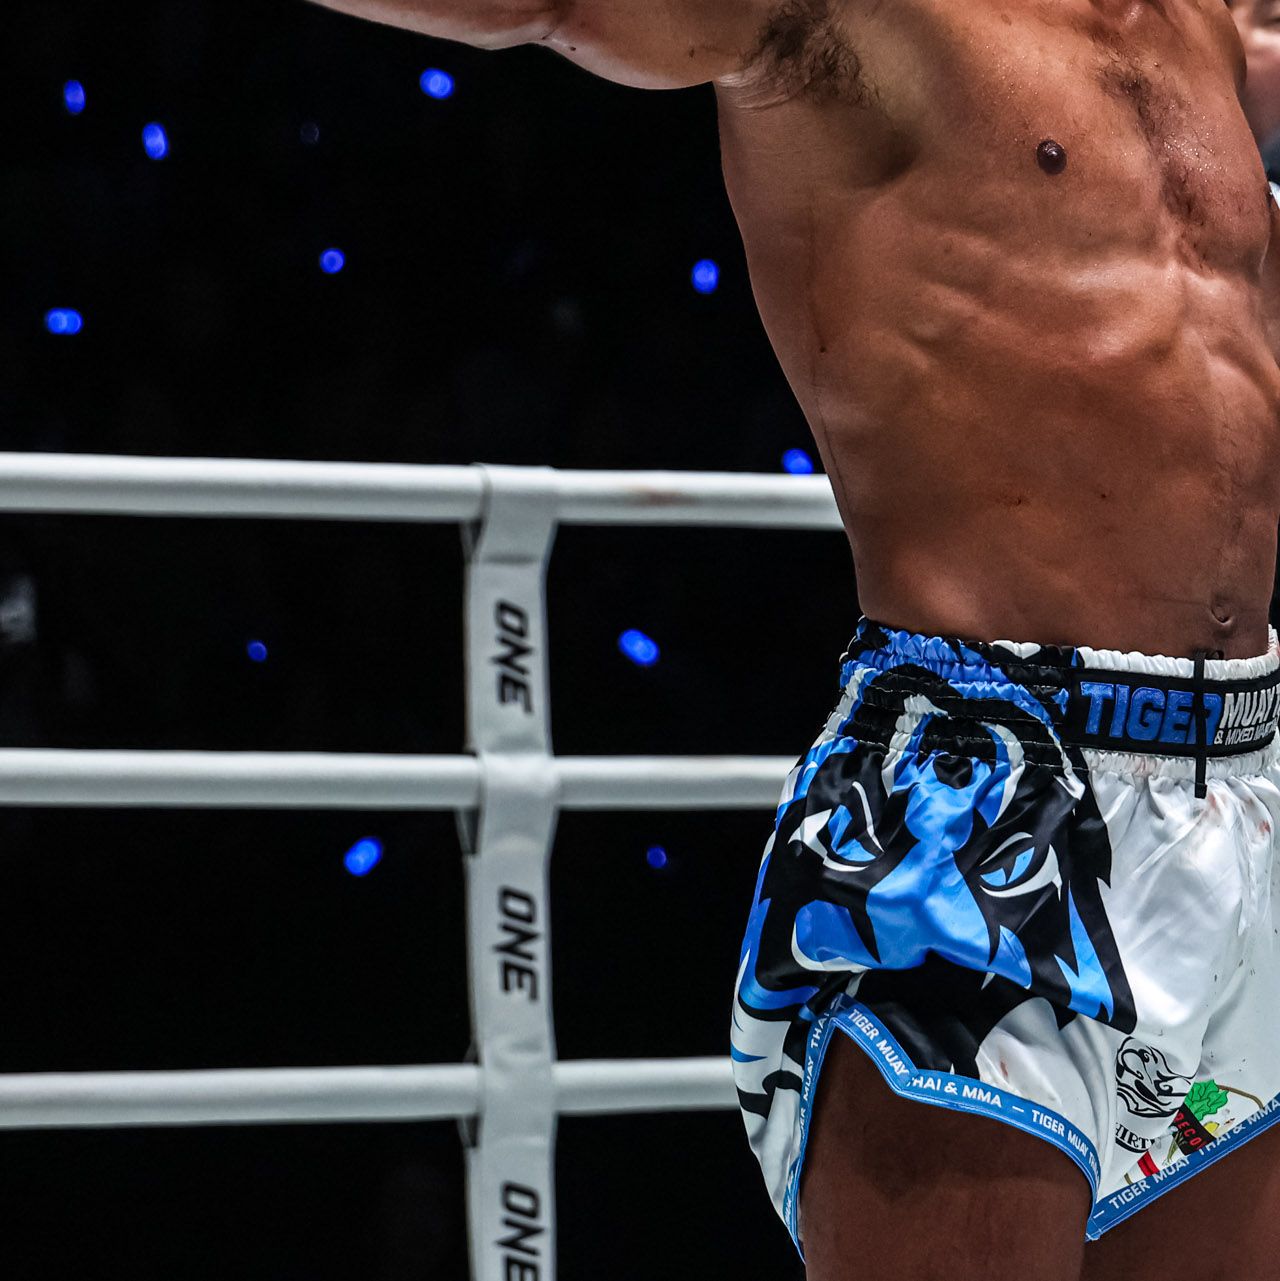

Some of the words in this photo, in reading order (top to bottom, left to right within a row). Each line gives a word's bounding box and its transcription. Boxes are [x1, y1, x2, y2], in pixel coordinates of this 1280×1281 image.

[492, 600, 533, 714] ONE
[1080, 681, 1222, 745] TIGER
[1219, 686, 1275, 729] MUAY
[493, 886, 541, 1001] ONE
[847, 1008, 880, 1041] TIGER
[875, 1038, 910, 1078] MUAY
[944, 1082, 958, 1096] &
[961, 1085, 1003, 1109] MMA
[1031, 1108, 1066, 1138] TIGER
[1067, 1129, 1089, 1158] MUAY
[1108, 1180, 1151, 1210] TIGER
[1153, 1155, 1192, 1183] MUAY
